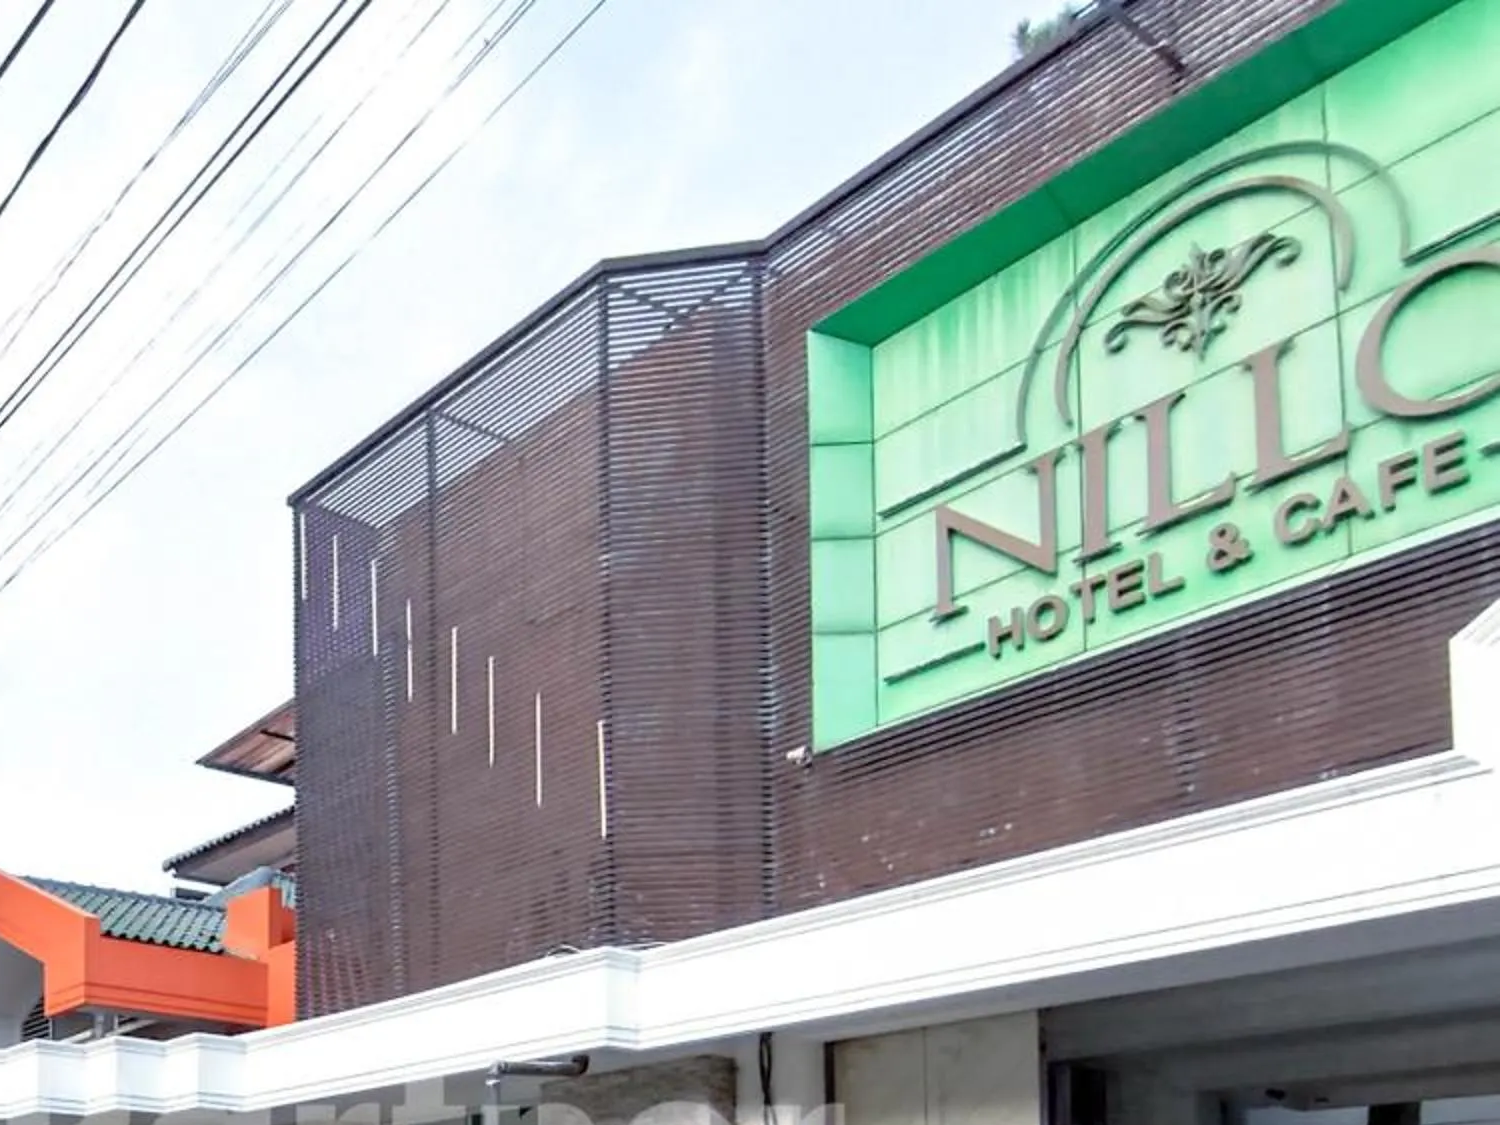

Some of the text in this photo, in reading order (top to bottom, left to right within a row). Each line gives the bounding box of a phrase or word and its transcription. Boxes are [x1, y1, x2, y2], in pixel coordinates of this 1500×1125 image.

[986, 430, 1471, 658] HOTEL & CAFE
